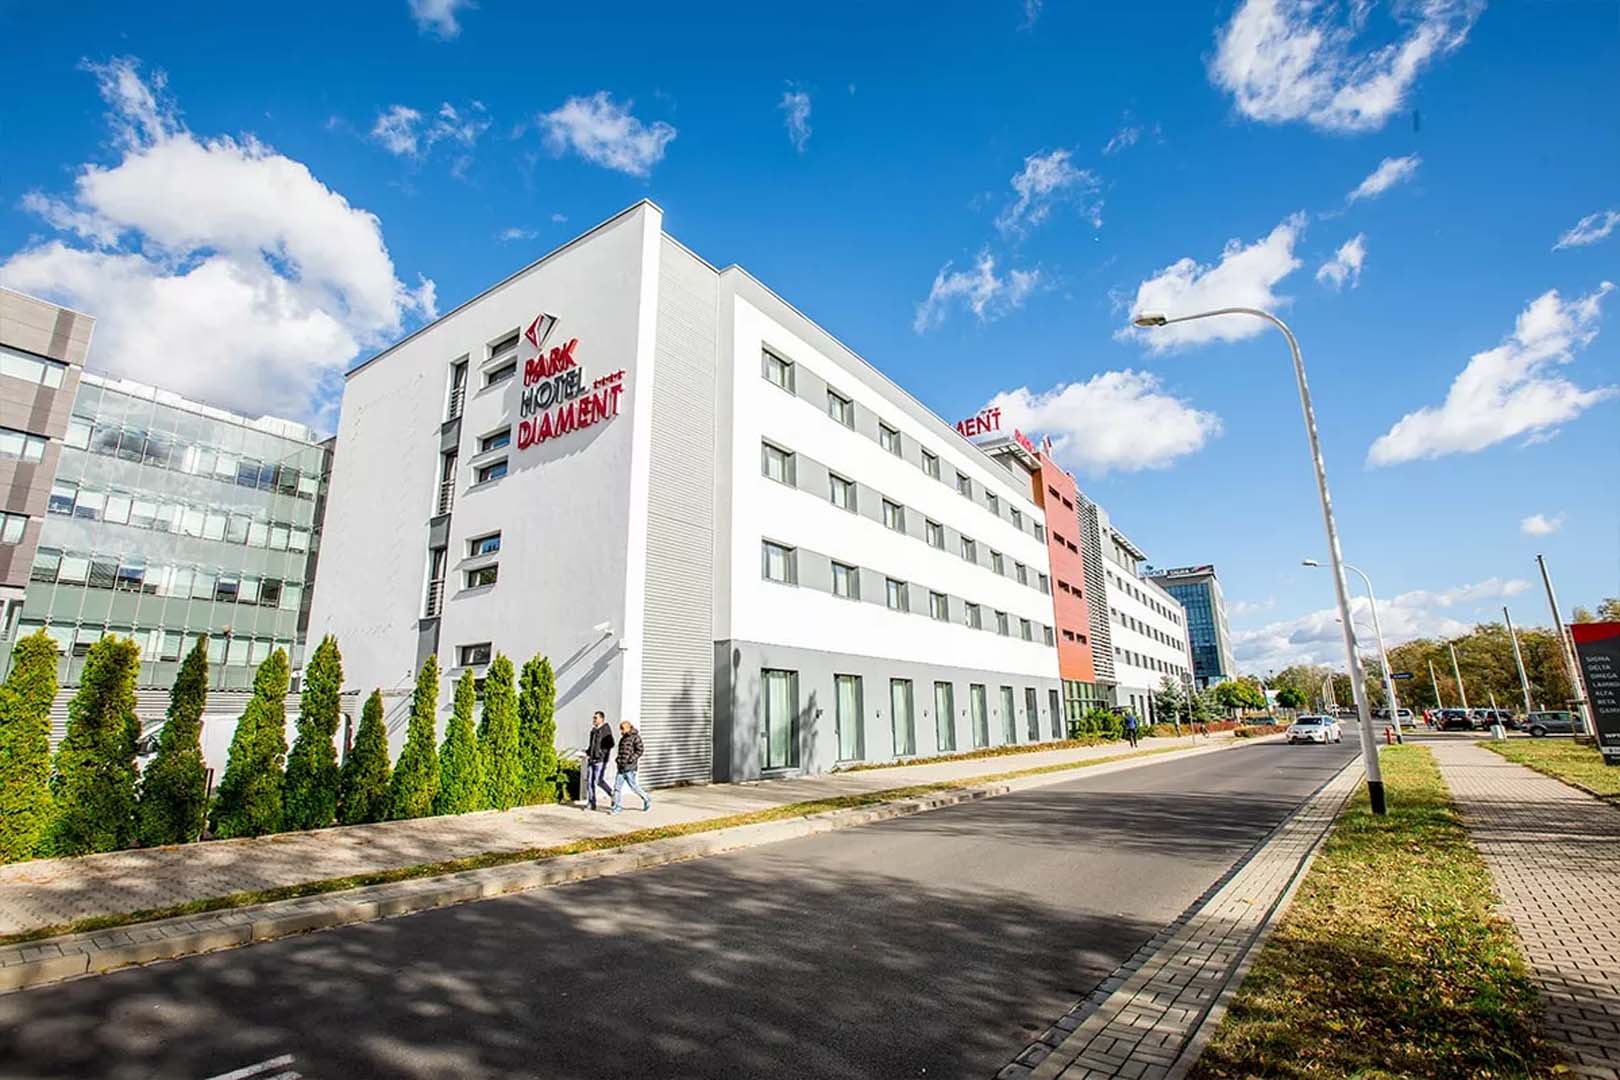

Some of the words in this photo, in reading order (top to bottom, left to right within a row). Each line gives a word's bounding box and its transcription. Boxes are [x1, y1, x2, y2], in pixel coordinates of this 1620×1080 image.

[524, 338, 578, 387] PARK
[517, 384, 624, 450] DIAMENT
[520, 367, 590, 418] HOTEL
